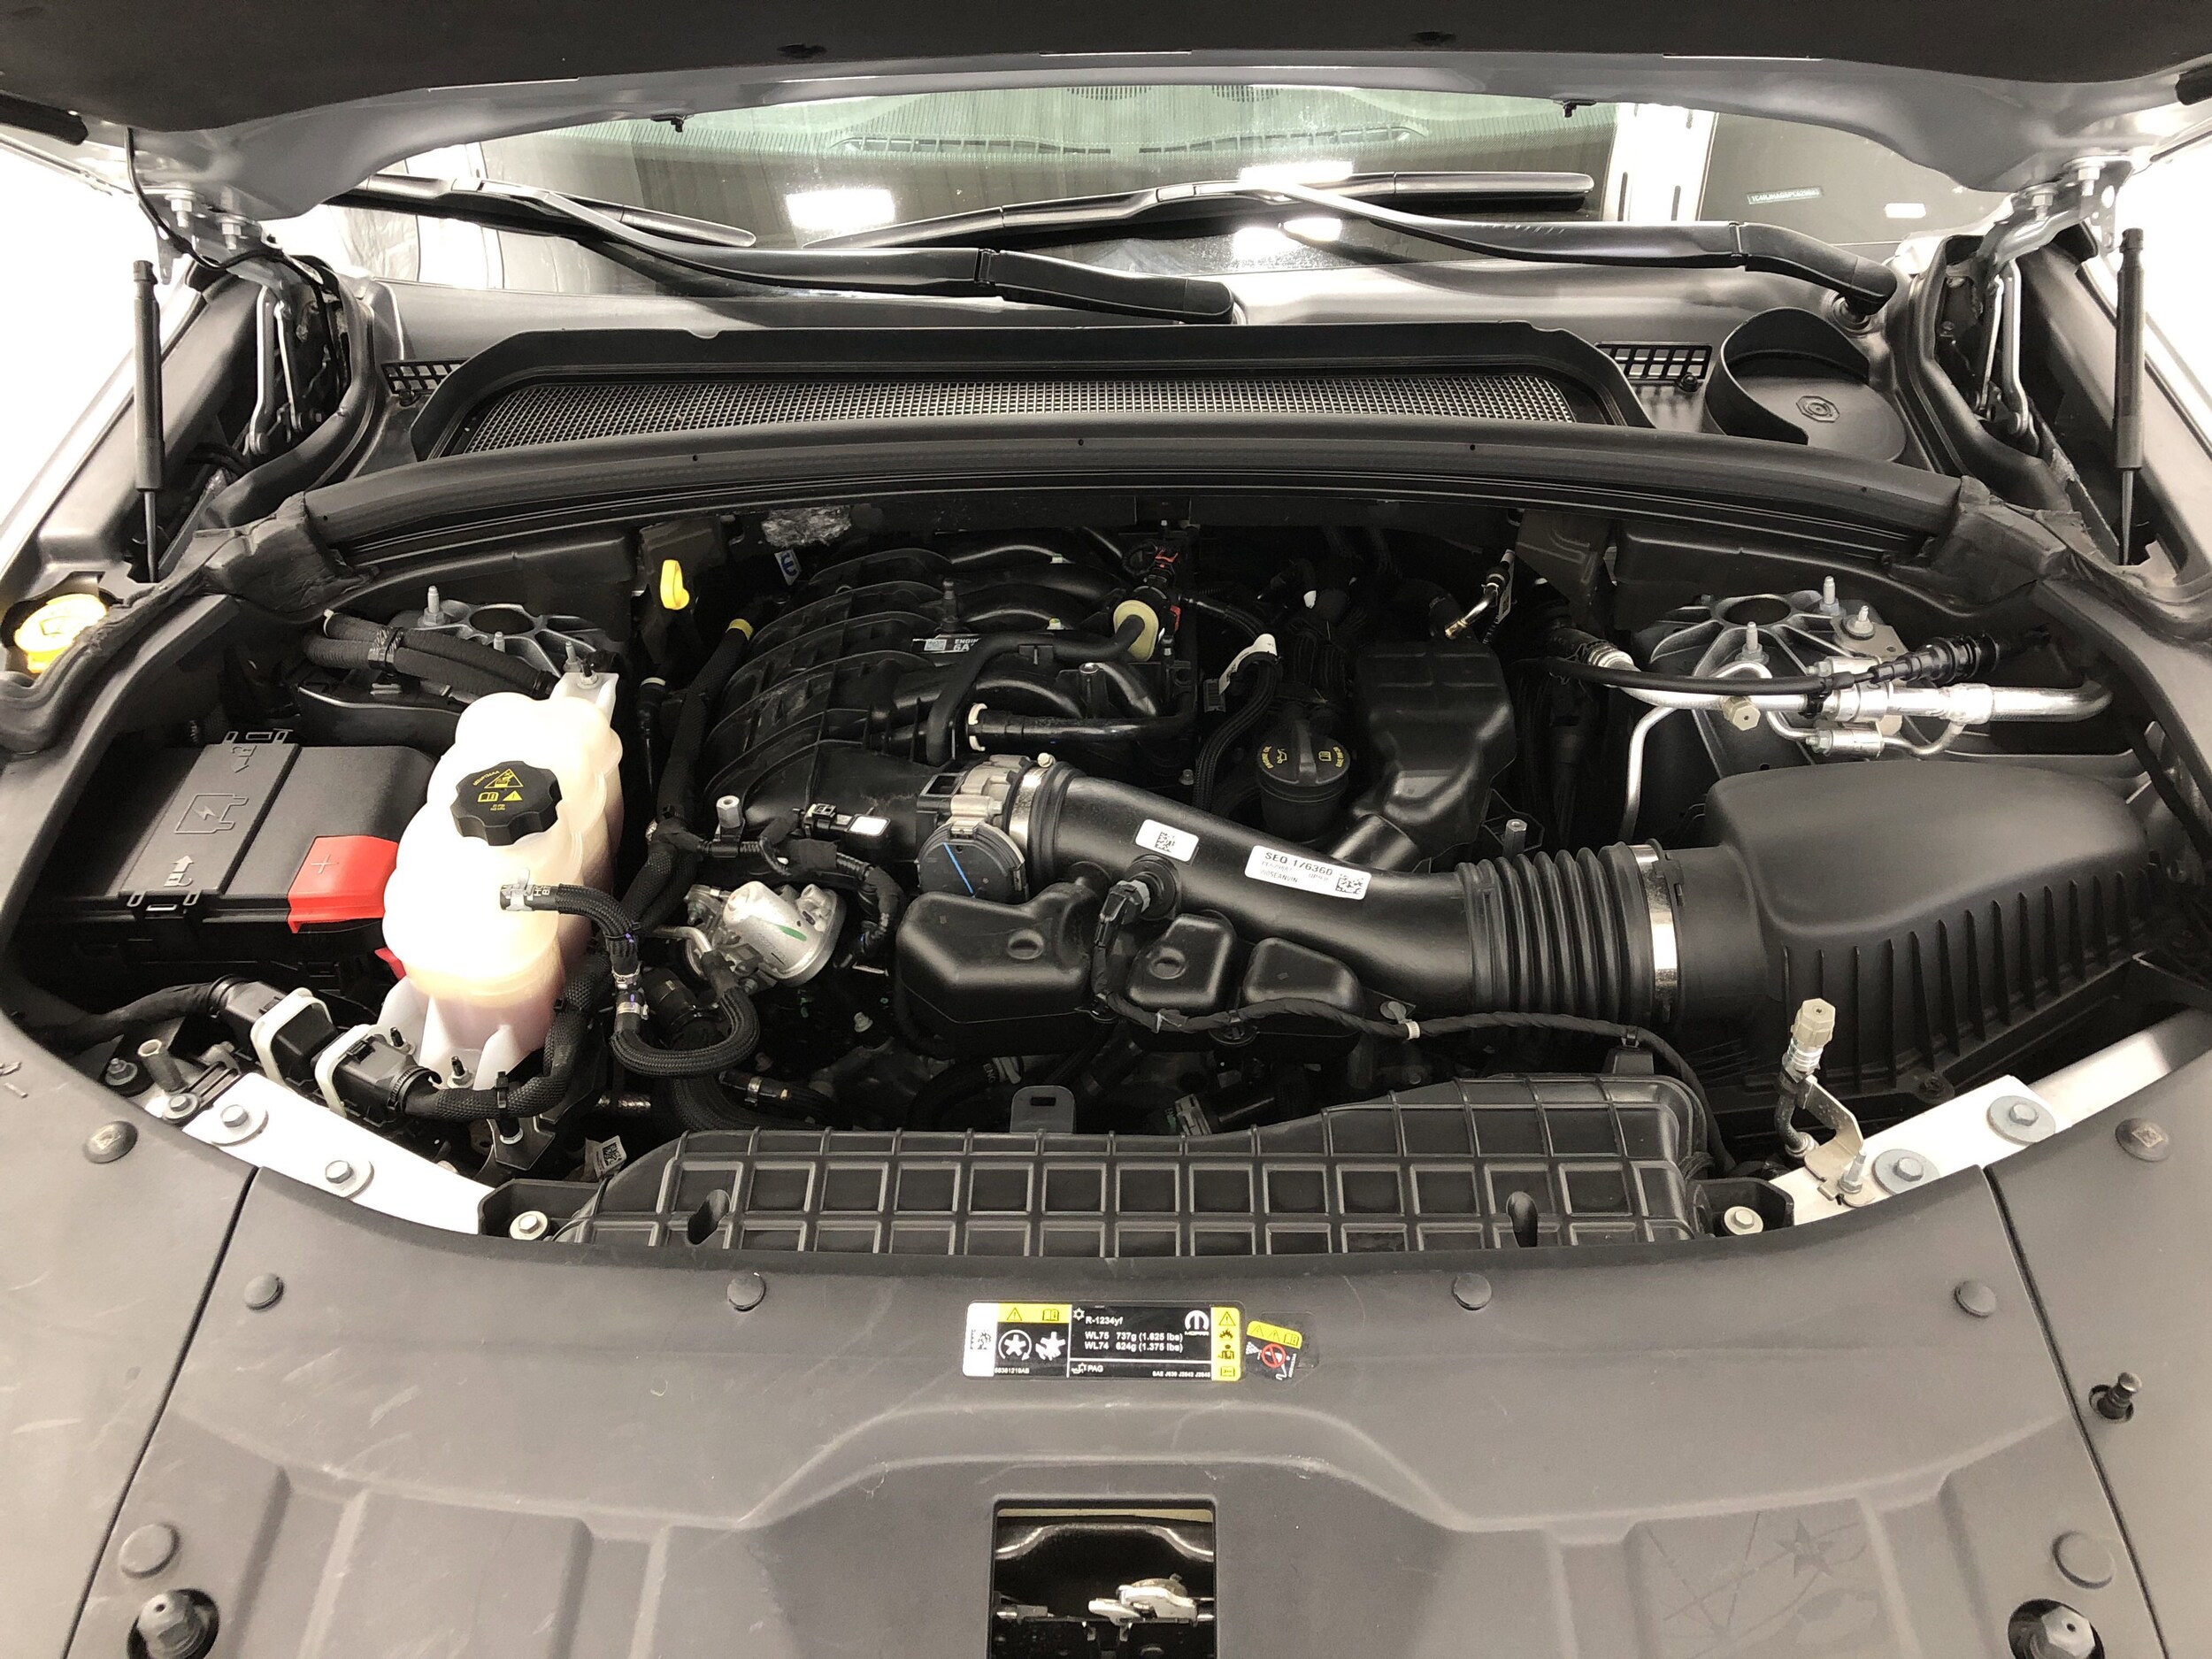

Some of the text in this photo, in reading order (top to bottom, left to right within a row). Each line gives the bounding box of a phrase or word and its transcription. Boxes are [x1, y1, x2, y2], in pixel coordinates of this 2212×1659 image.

[1085, 1316, 1124, 1327] R-1234yf
[1085, 1331, 1110, 1340] WL75
[1116, 1332, 1137, 1342] 737g
[1084, 1340, 1110, 1350] WL74
[1115, 1341, 1137, 1353] 624g
[1087, 1364, 1104, 1373] PAG
